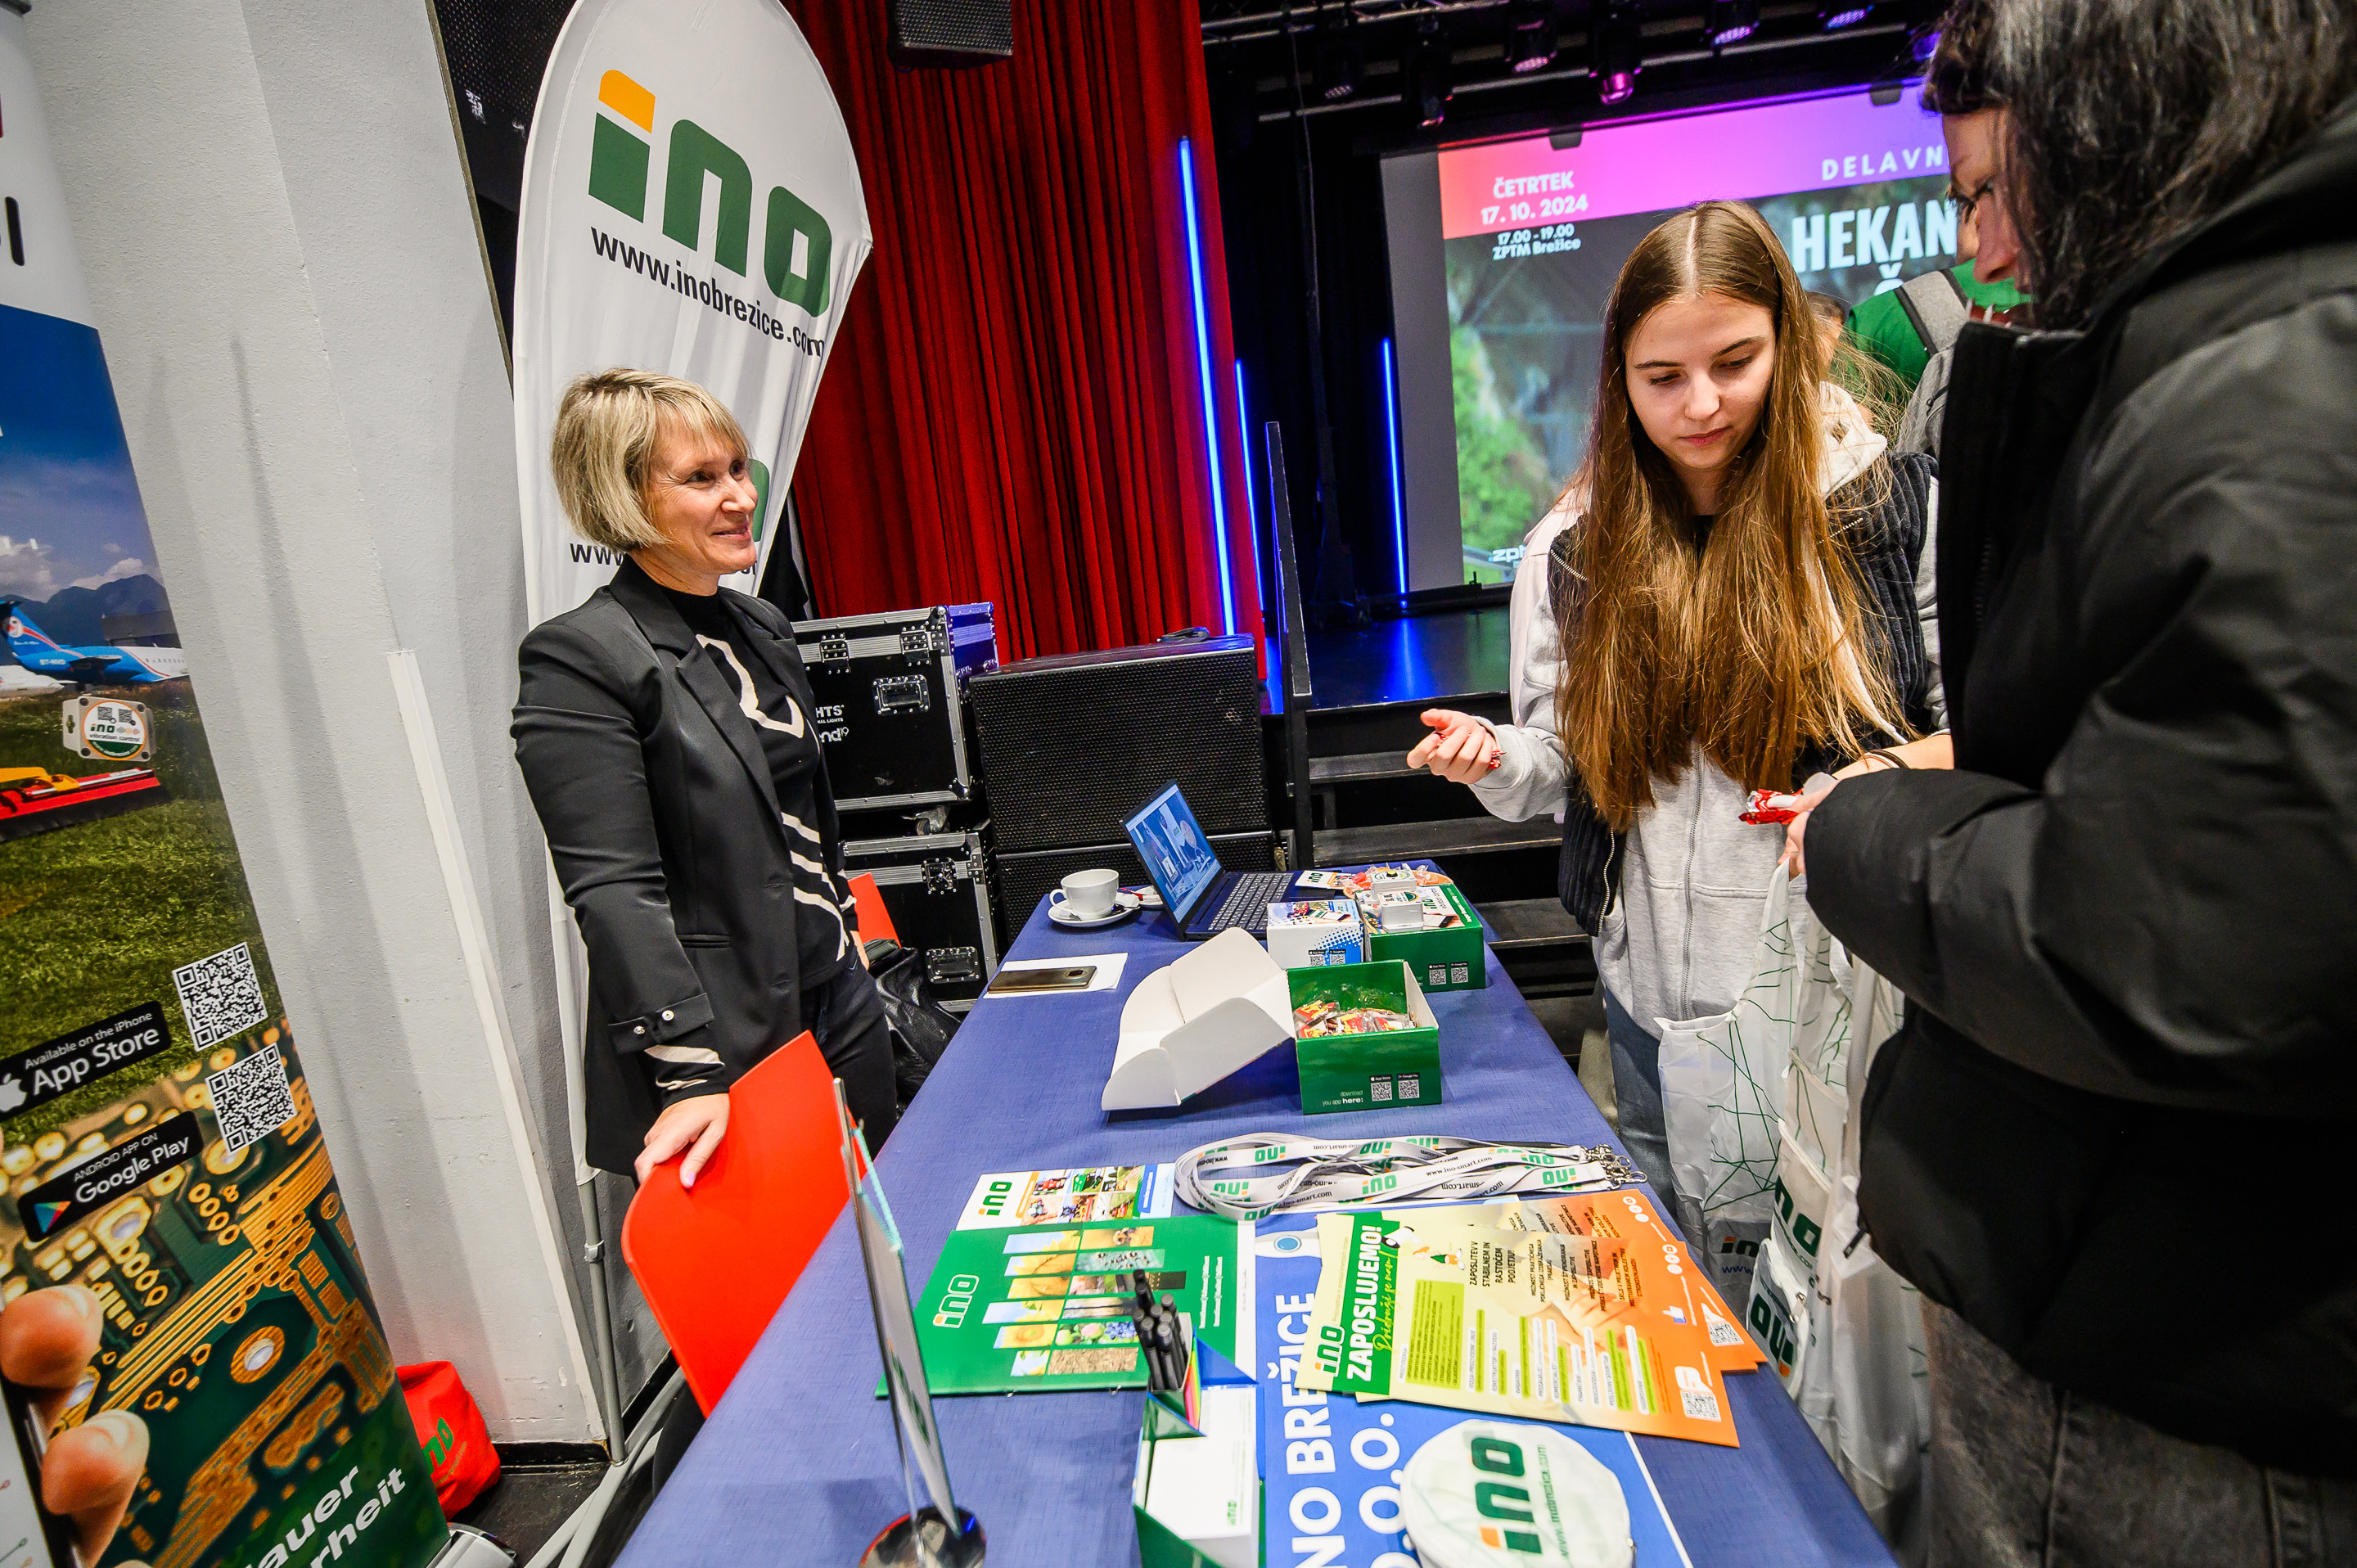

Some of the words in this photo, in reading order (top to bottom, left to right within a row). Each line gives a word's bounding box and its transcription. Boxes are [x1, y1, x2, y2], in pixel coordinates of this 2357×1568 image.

[1822, 145, 1944, 181] DELAVN
[588, 70, 832, 318] ino
[1494, 170, 1575, 199] ČETRTEK
[1539, 194, 1589, 217] 2024
[1492, 243, 1532, 261] ZPTM
[1497, 229, 1532, 246] 17.00
[1540, 223, 1575, 241] 19.00
[1791, 199, 1958, 273] HEKAN
[590, 226, 825, 358] www.inobrezice.com
[91, 723, 115, 733] ino
[25, 1043, 77, 1070] Available
[79, 1035, 94, 1048] on
[94, 1026, 115, 1042] the
[114, 1012, 153, 1033] iPhone
[34, 1057, 89, 1096] App
[92, 1028, 160, 1067] Store
[74, 1152, 120, 1183] ANDROID
[122, 1142, 140, 1157] APP
[141, 1132, 159, 1147] ON
[1255, 1146, 1286, 1162] ino
[1359, 1142, 1392, 1154] ino
[75, 1157, 151, 1203] Google
[151, 1136, 189, 1165] Play
[1362, 1174, 1397, 1195] ino
[1543, 1167, 1577, 1185] ino
[979, 1180, 1012, 1216] ino
[1470, 1246, 1478, 1286] ZAPOSLITEV
[1482, 1249, 1490, 1287] STABILNEM
[1493, 1248, 1503, 1283] RASTOČEM
[933, 1273, 980, 1328] ino
[1346, 1225, 1382, 1381] ZAPOSLUJEMO!
[1314, 1325, 1345, 1377] ino
[1751, 1292, 1795, 1378] ino
[1471, 1437, 1543, 1555] ino
